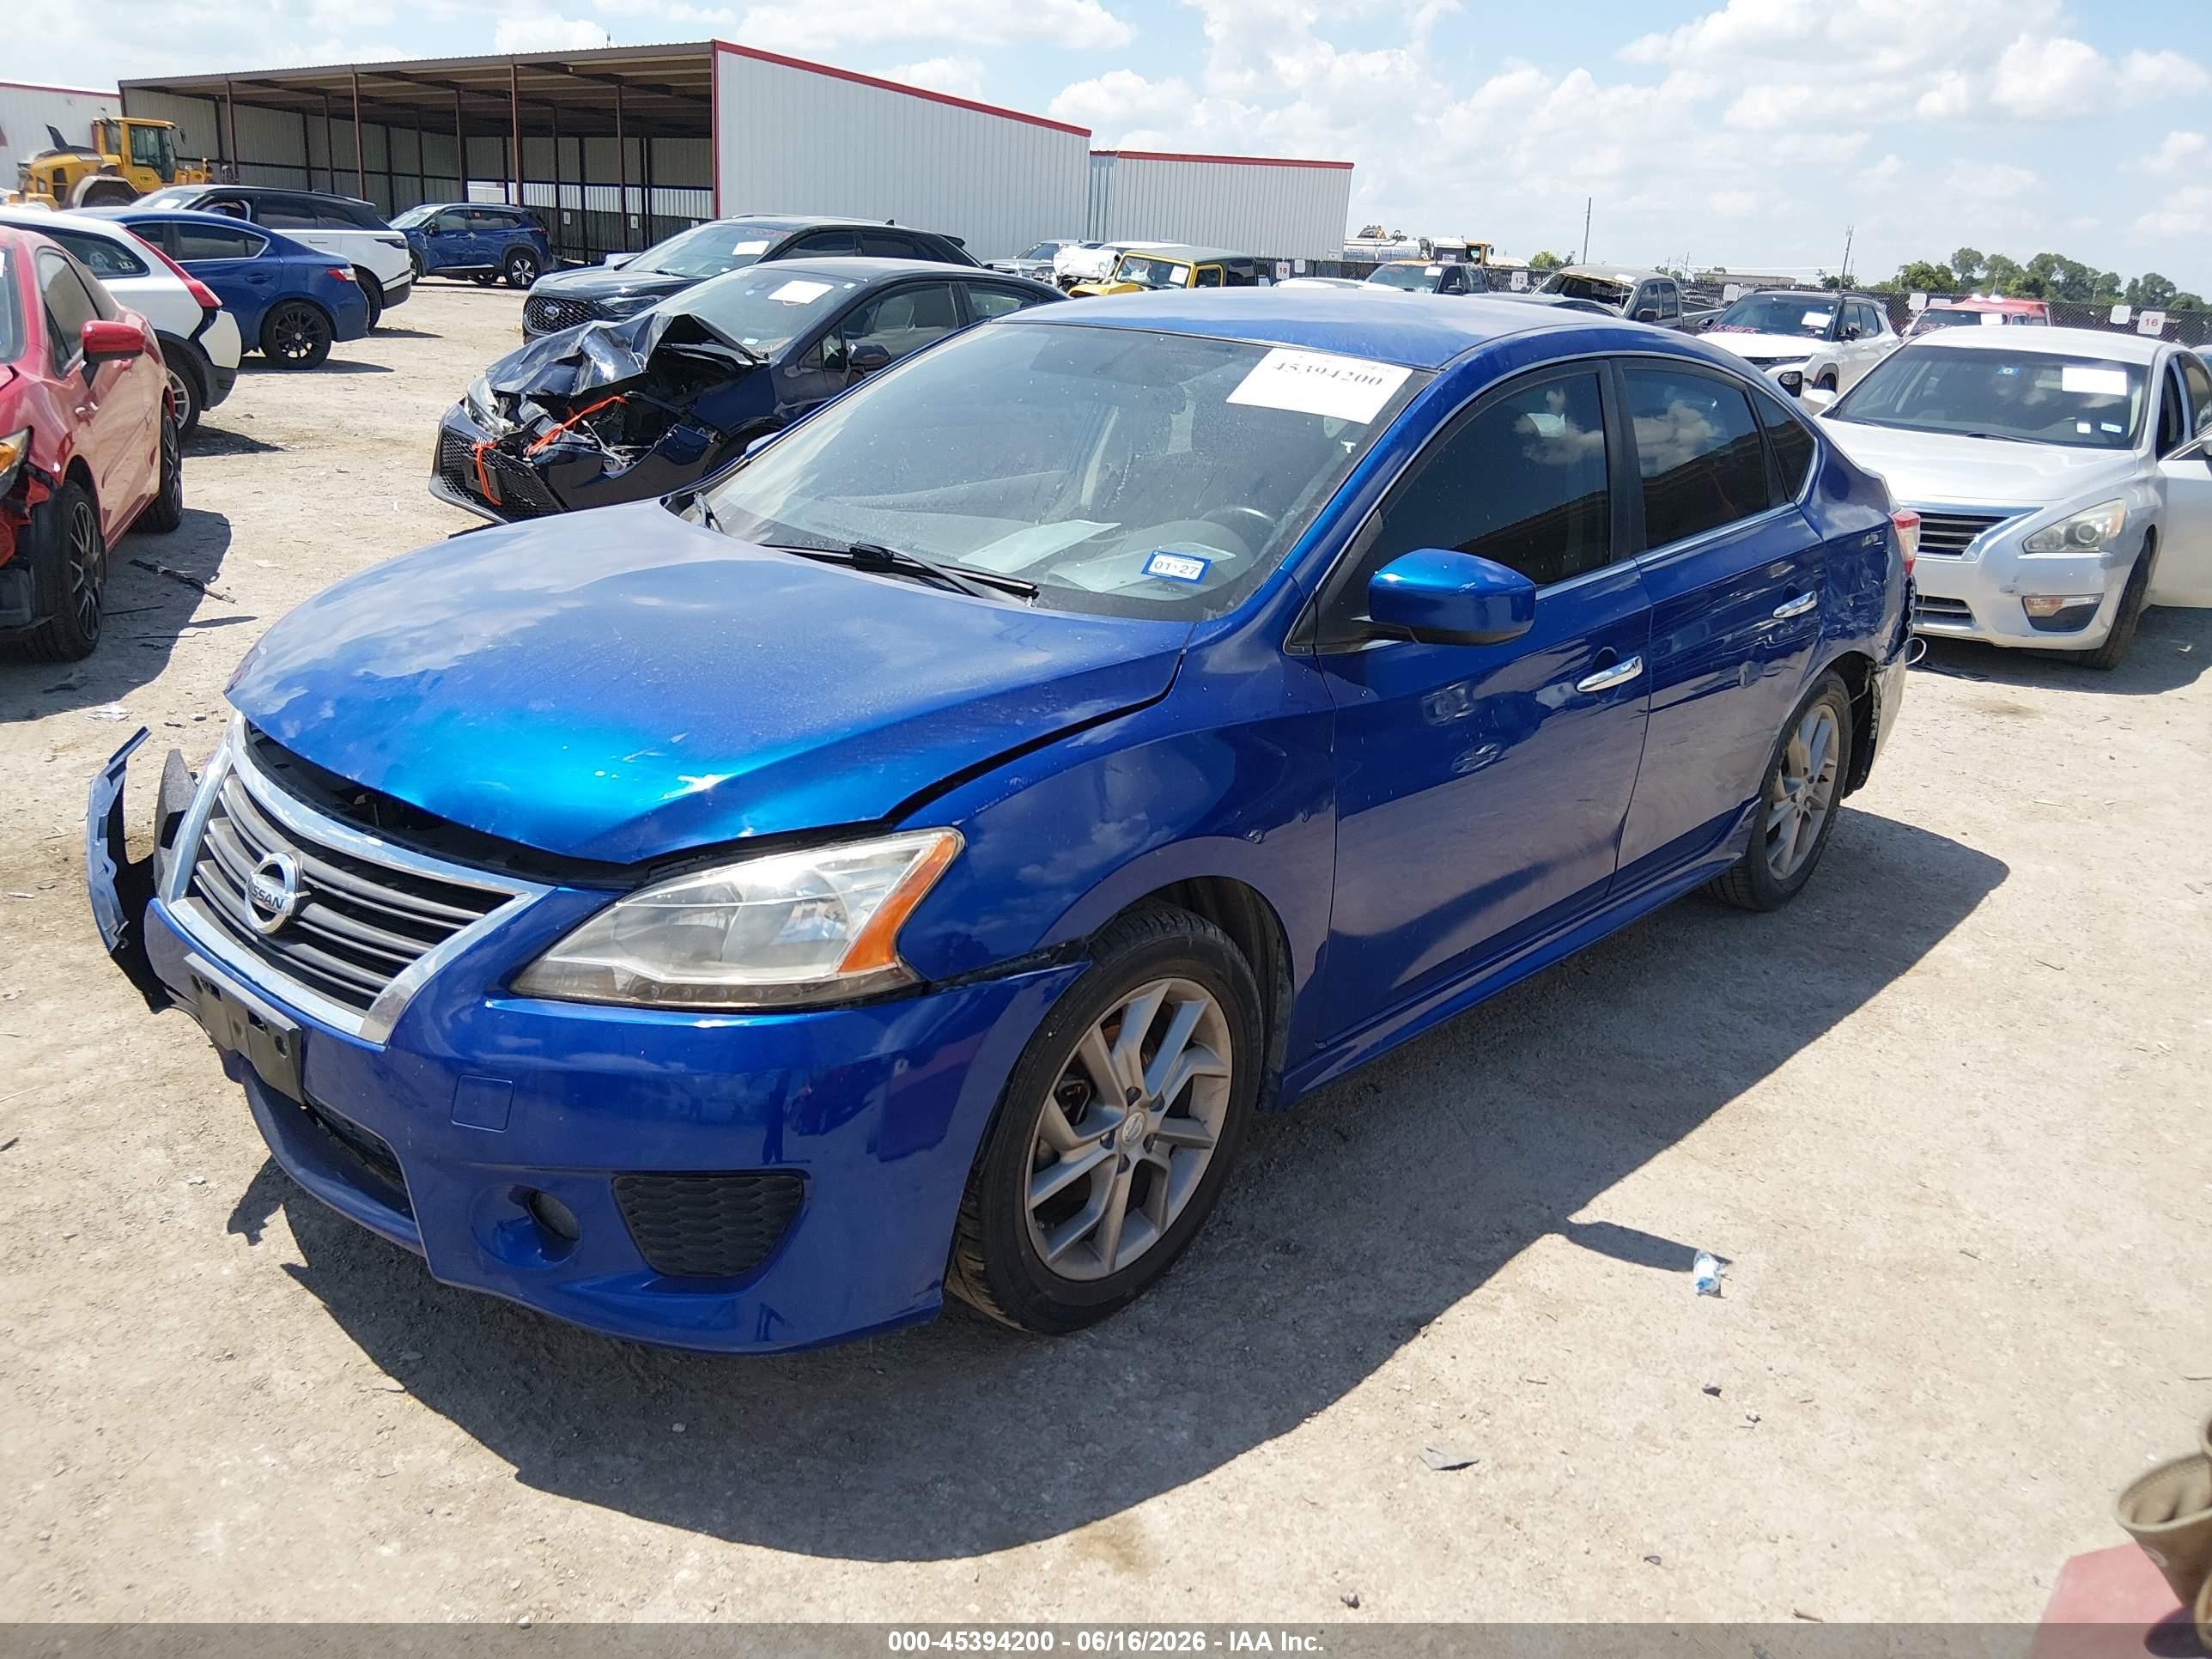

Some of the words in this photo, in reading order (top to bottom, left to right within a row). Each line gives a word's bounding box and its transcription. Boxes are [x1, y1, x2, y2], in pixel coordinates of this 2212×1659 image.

[2145, 318, 2158, 327] 16
[1272, 362, 1383, 386] 45394200
[247, 878, 284, 909] NISSAN
